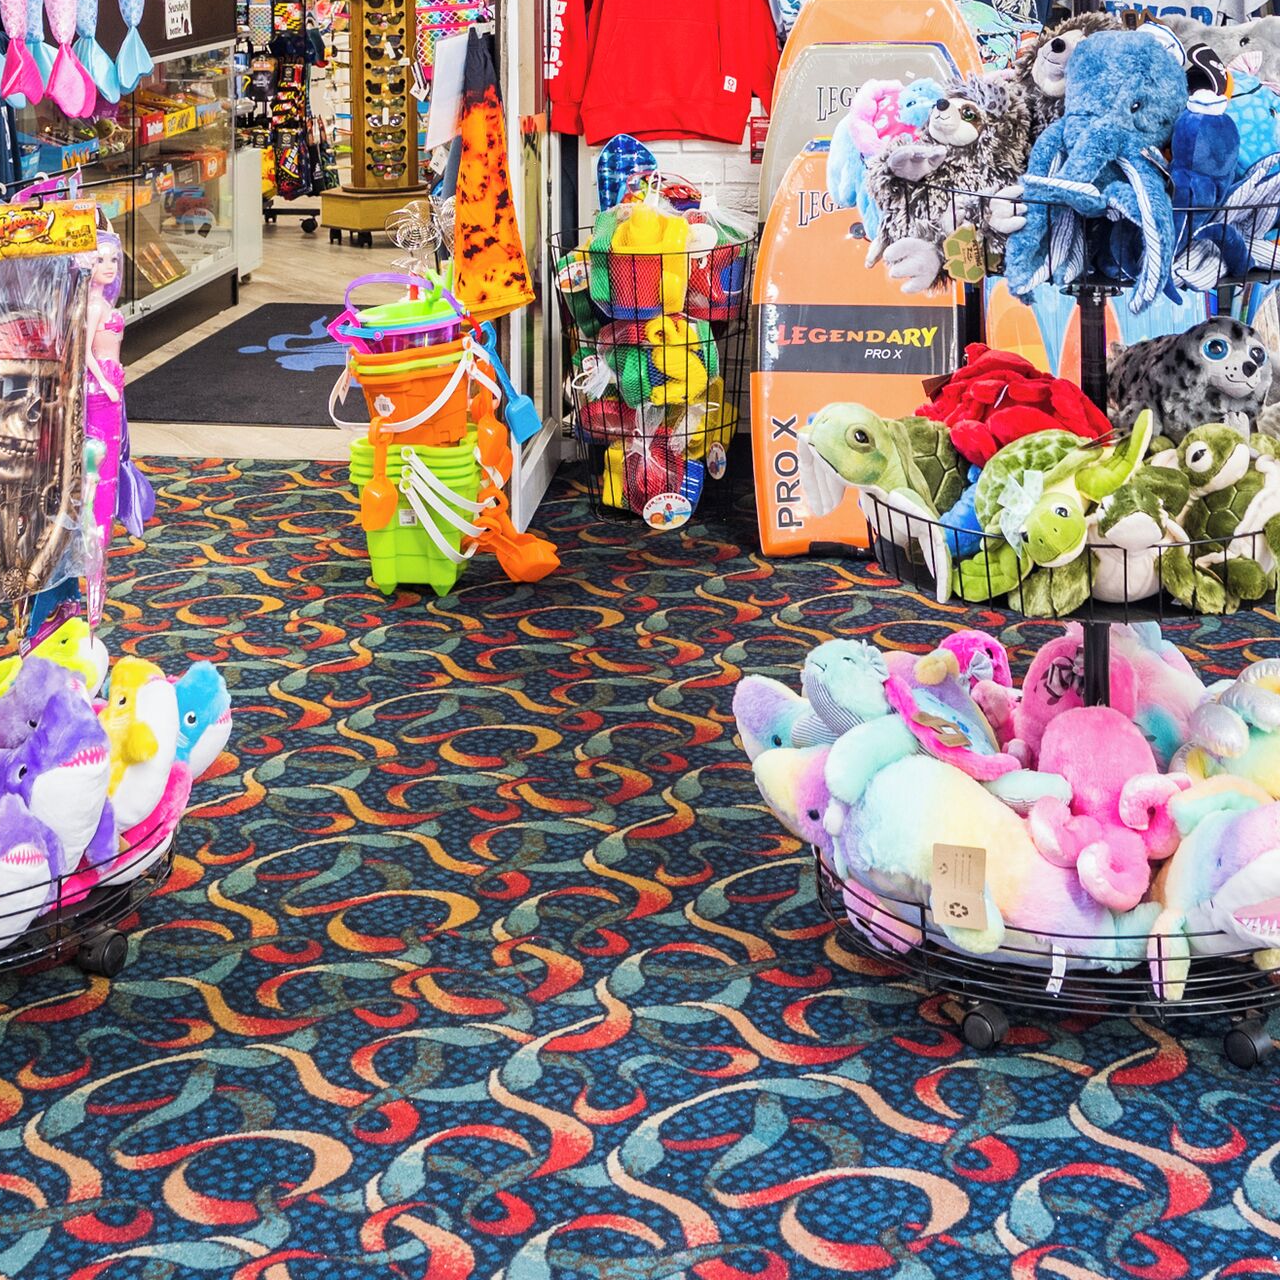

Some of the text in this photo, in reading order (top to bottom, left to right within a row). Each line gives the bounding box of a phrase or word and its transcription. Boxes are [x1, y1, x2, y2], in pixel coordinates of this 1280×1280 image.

[774, 325, 939, 348] LEGENDARY
[864, 348, 903, 360] PRO X
[773, 415, 804, 530] PRO X
